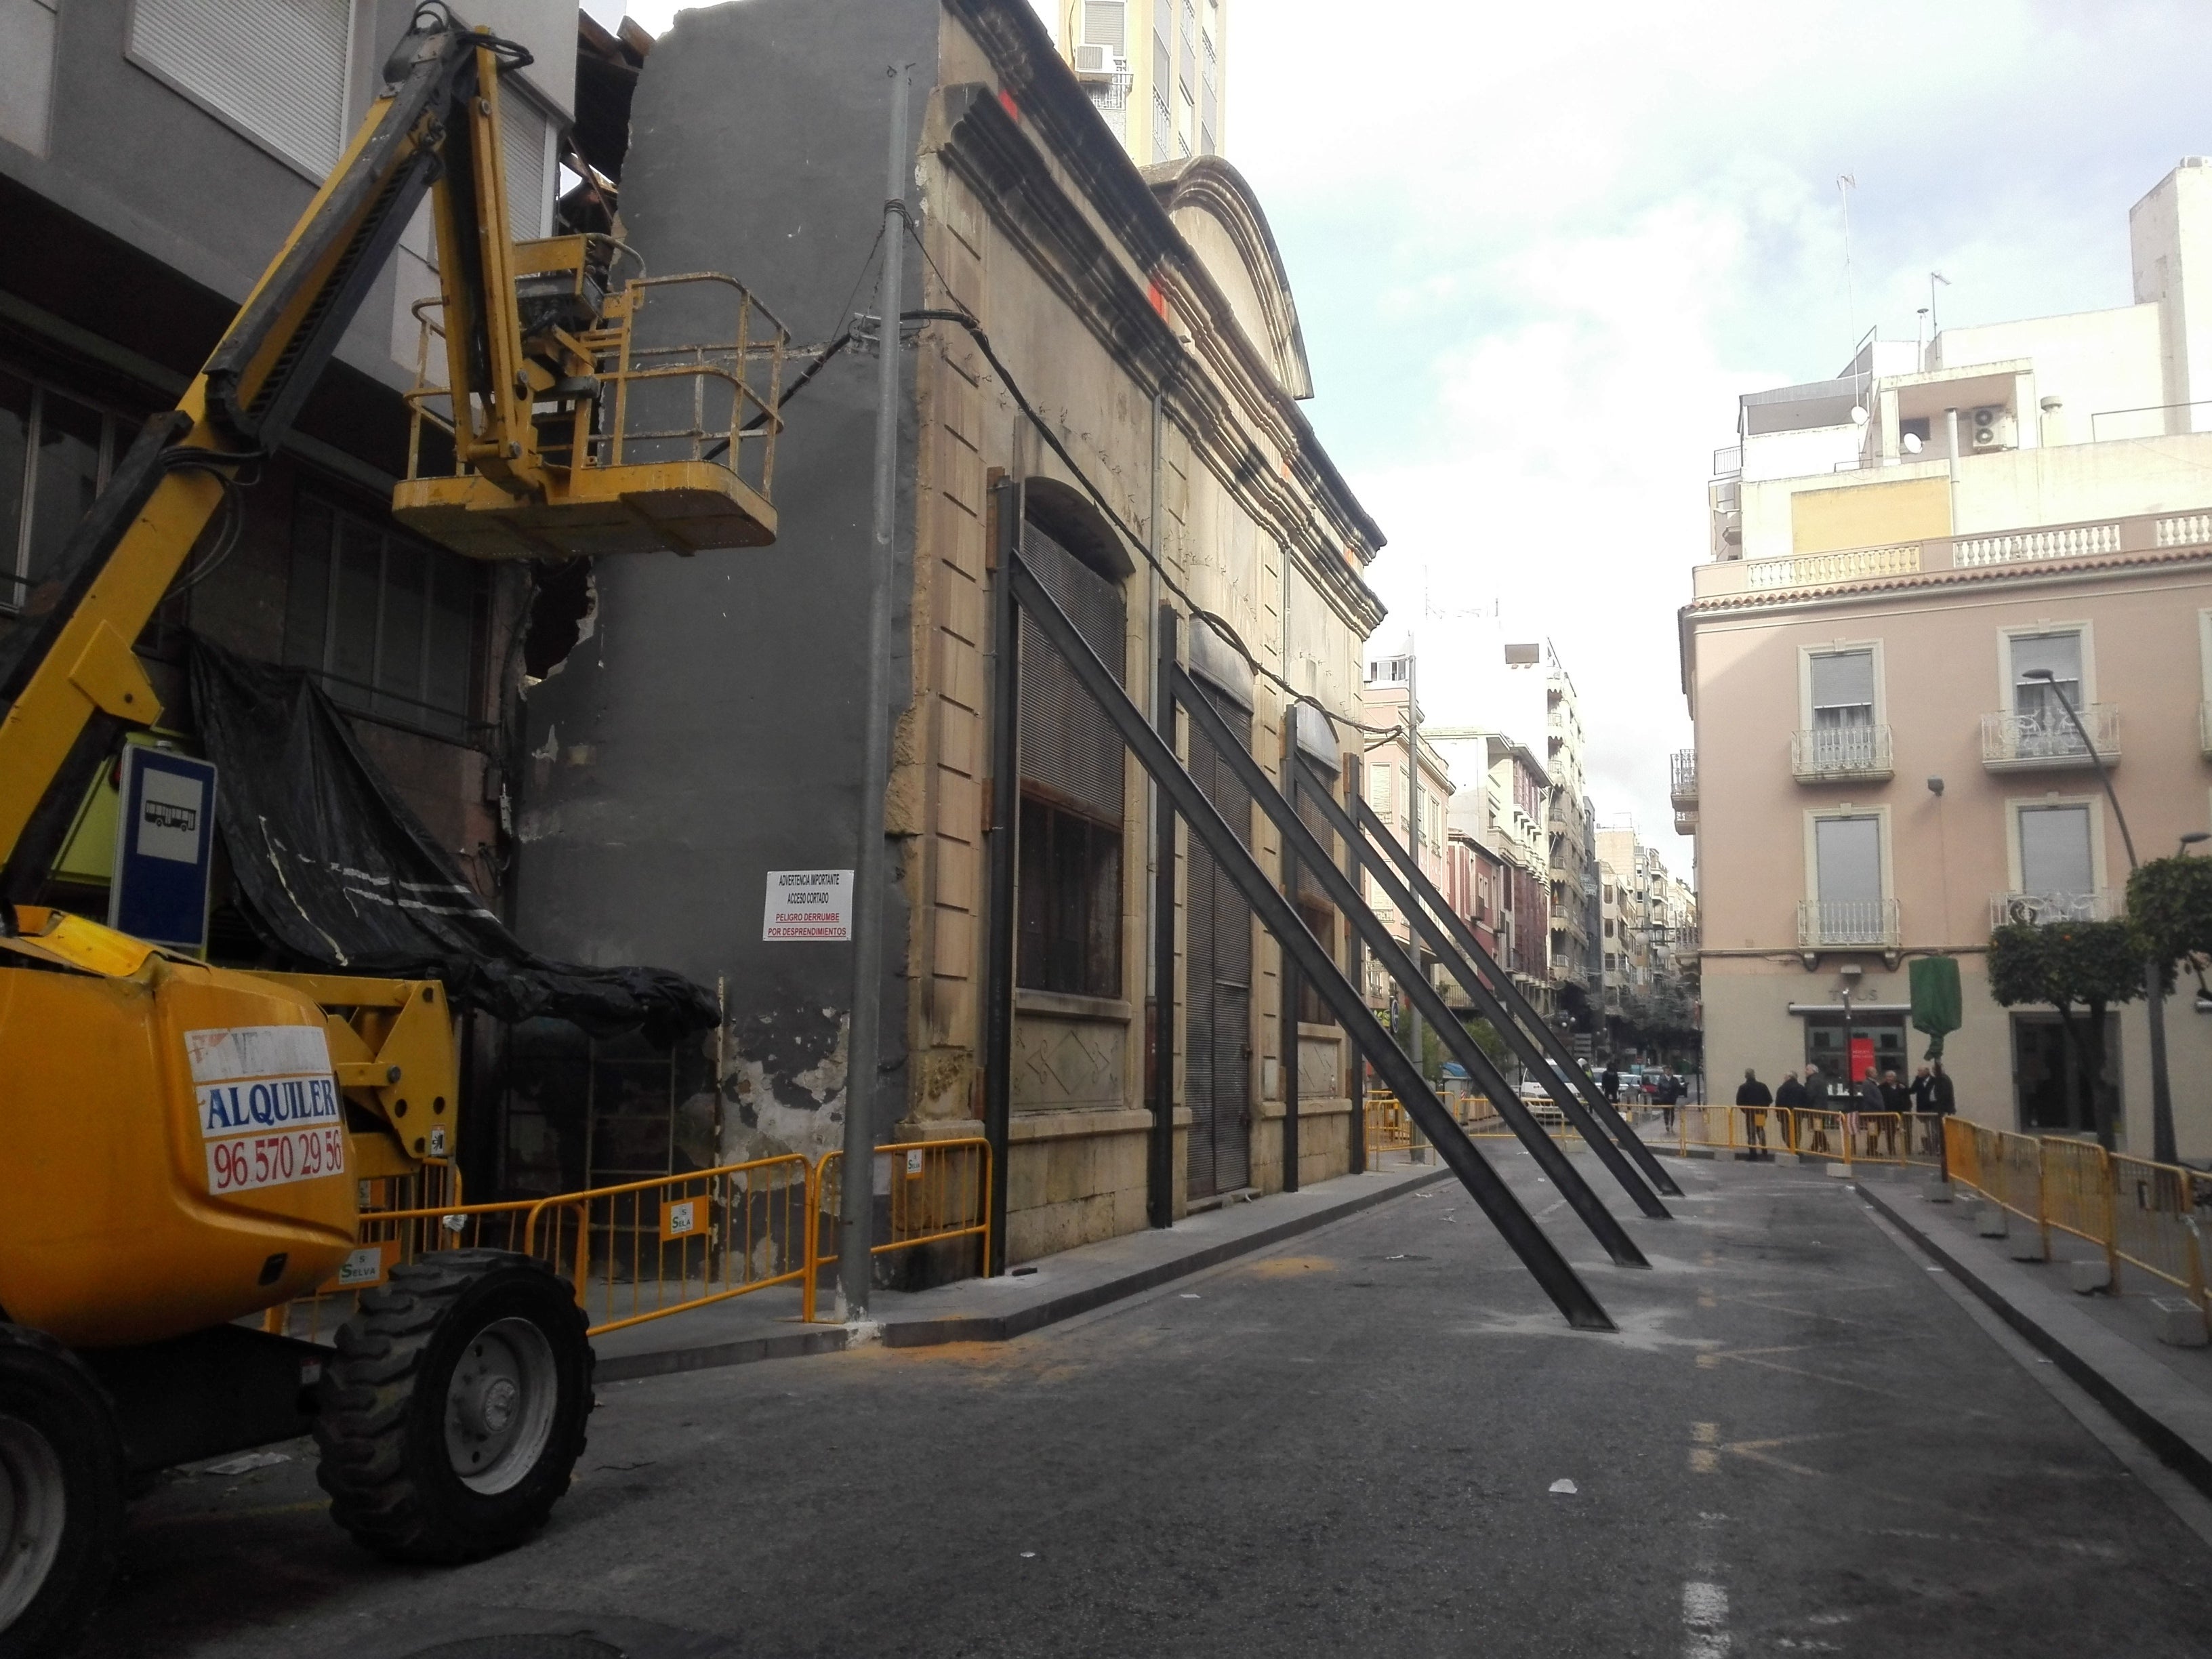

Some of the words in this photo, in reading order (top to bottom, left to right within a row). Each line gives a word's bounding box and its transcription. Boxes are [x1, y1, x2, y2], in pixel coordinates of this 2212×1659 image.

[779, 874, 810, 886] ADVERTENCIA
[811, 874, 840, 885] IMPORTANTE
[787, 893, 806, 904] ACCESO
[806, 892, 829, 903] CORTADO
[775, 913, 802, 922] PELIGRO
[804, 913, 840, 921] DERRUMBE
[768, 928, 781, 936] POR
[782, 927, 846, 936] DESPRENDIMIENTOS
[1828, 989, 1877, 1001] TUS
[206, 1079, 336, 1129] ALQUILER
[213, 1141, 248, 1189] 96
[255, 1135, 293, 1183] 570
[299, 1132, 321, 1175] 29
[326, 1130, 342, 1171] 56
[672, 1216, 691, 1228] SELA
[341, 1264, 375, 1278] SELVA
